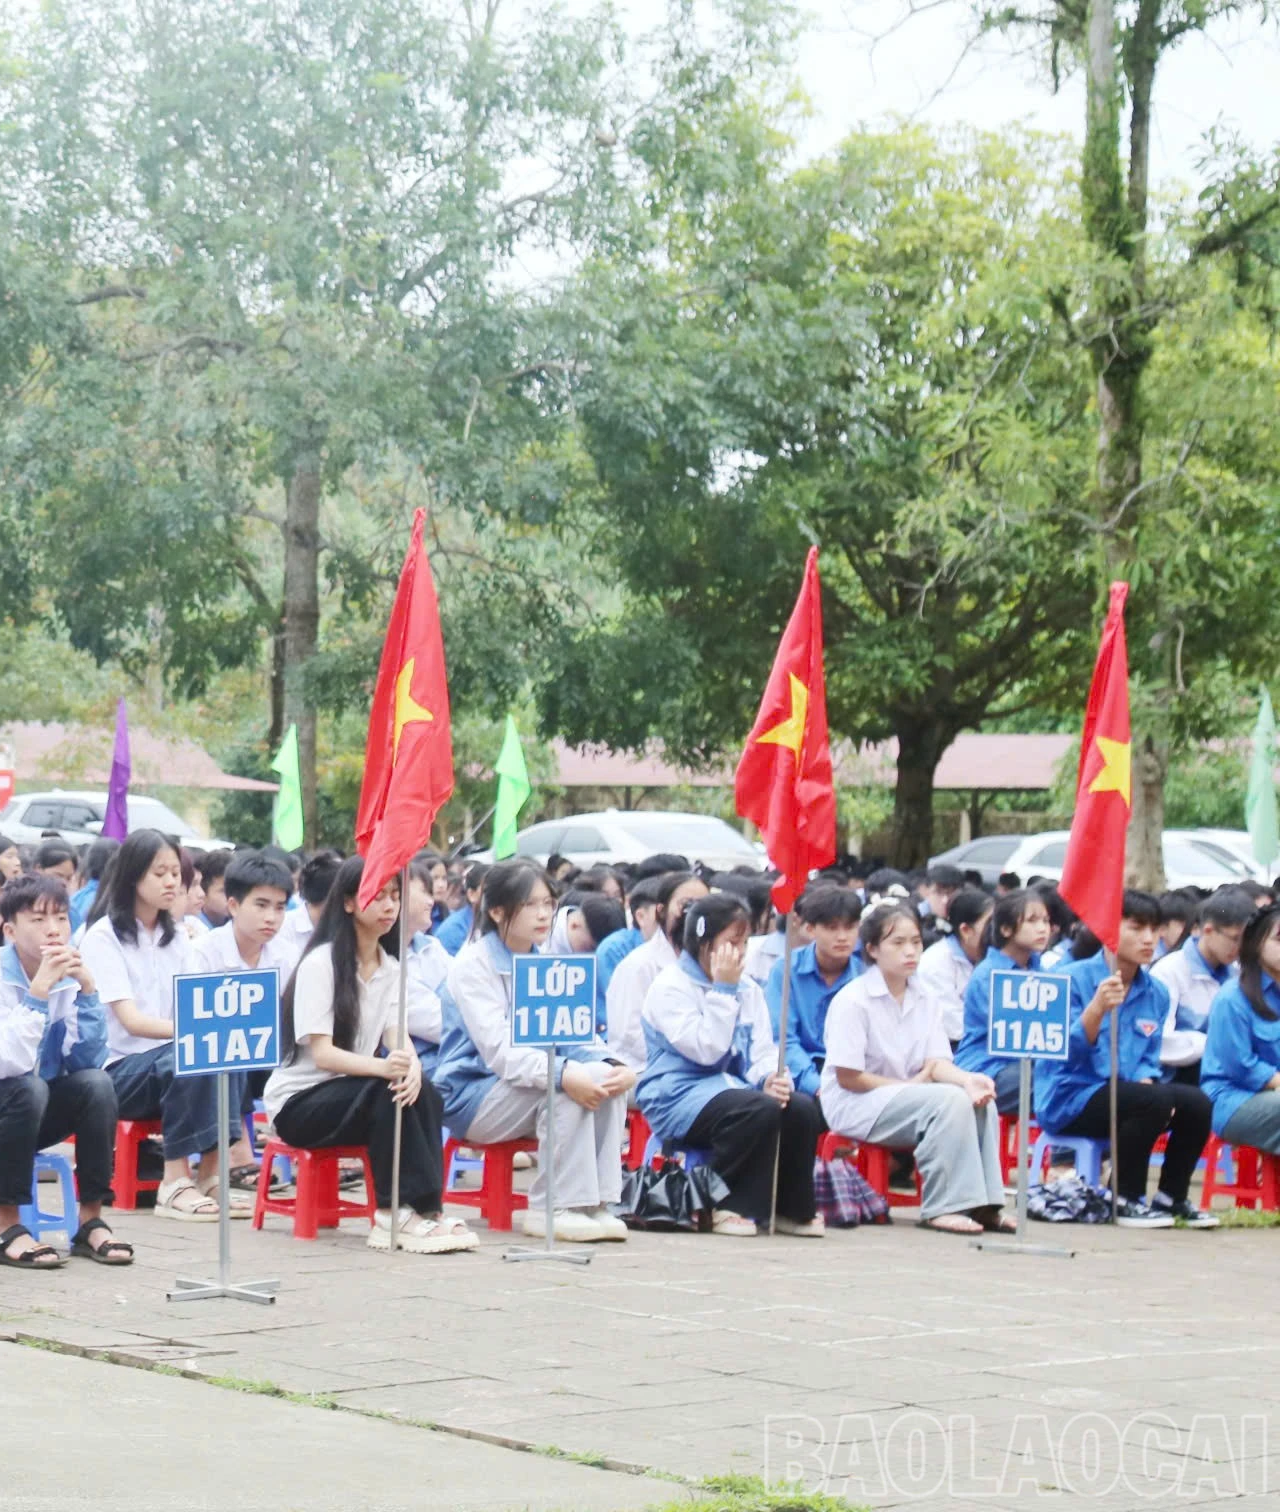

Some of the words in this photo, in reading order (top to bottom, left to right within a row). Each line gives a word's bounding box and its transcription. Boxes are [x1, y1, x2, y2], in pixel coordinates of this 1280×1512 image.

[527, 959, 587, 997] LỚP
[1002, 972, 1058, 1012] LỚP
[192, 978, 265, 1020] LỚP
[513, 1005, 592, 1037] 11A6
[991, 1019, 1064, 1053] 11A5
[178, 1027, 274, 1068] 11A7
